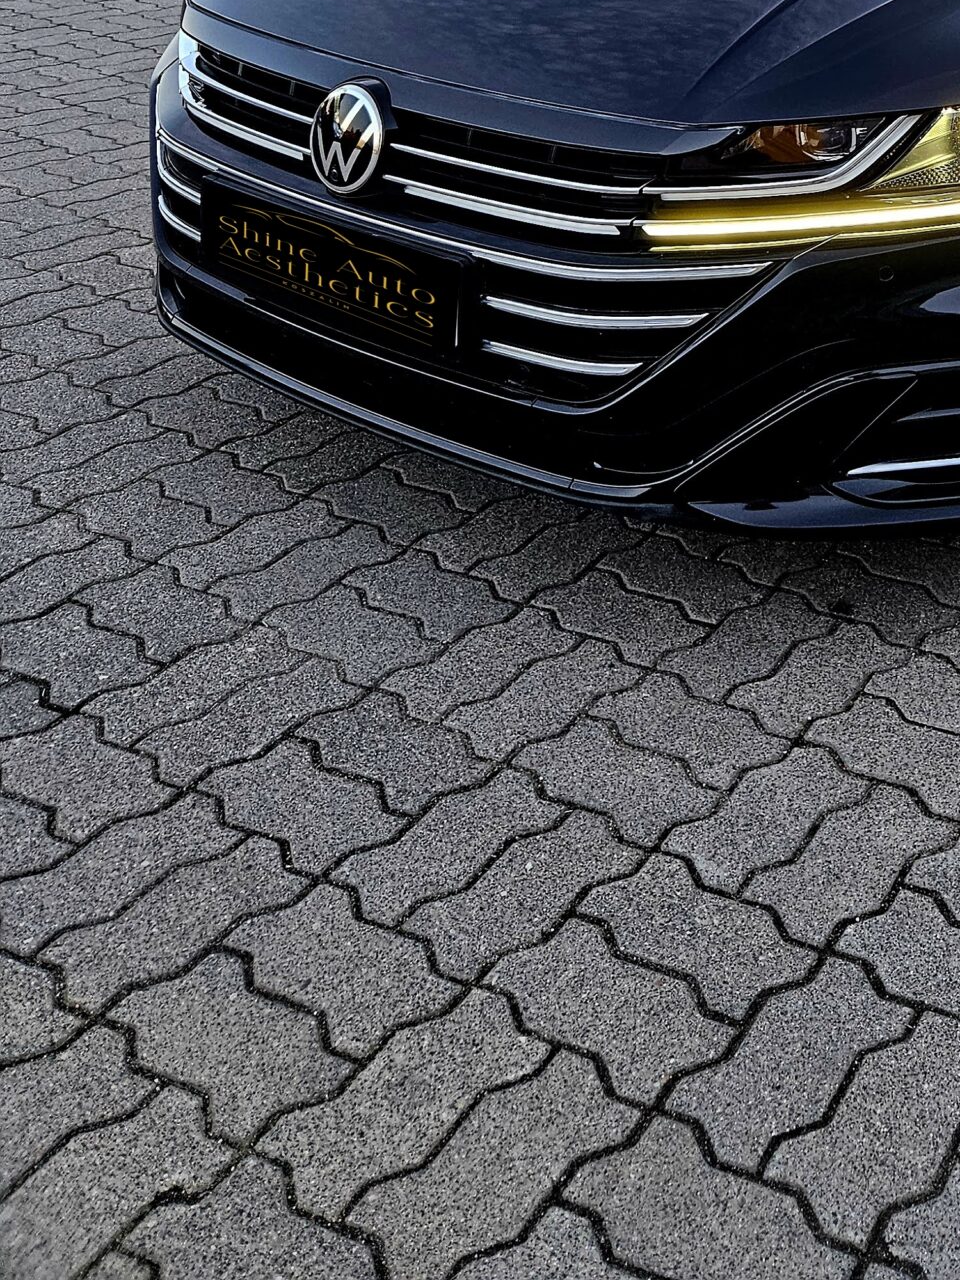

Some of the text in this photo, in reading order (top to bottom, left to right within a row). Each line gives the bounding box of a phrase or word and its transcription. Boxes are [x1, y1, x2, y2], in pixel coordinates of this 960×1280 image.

[218, 215, 436, 305] Shine Auto
[219, 236, 435, 329] Aesthetics
